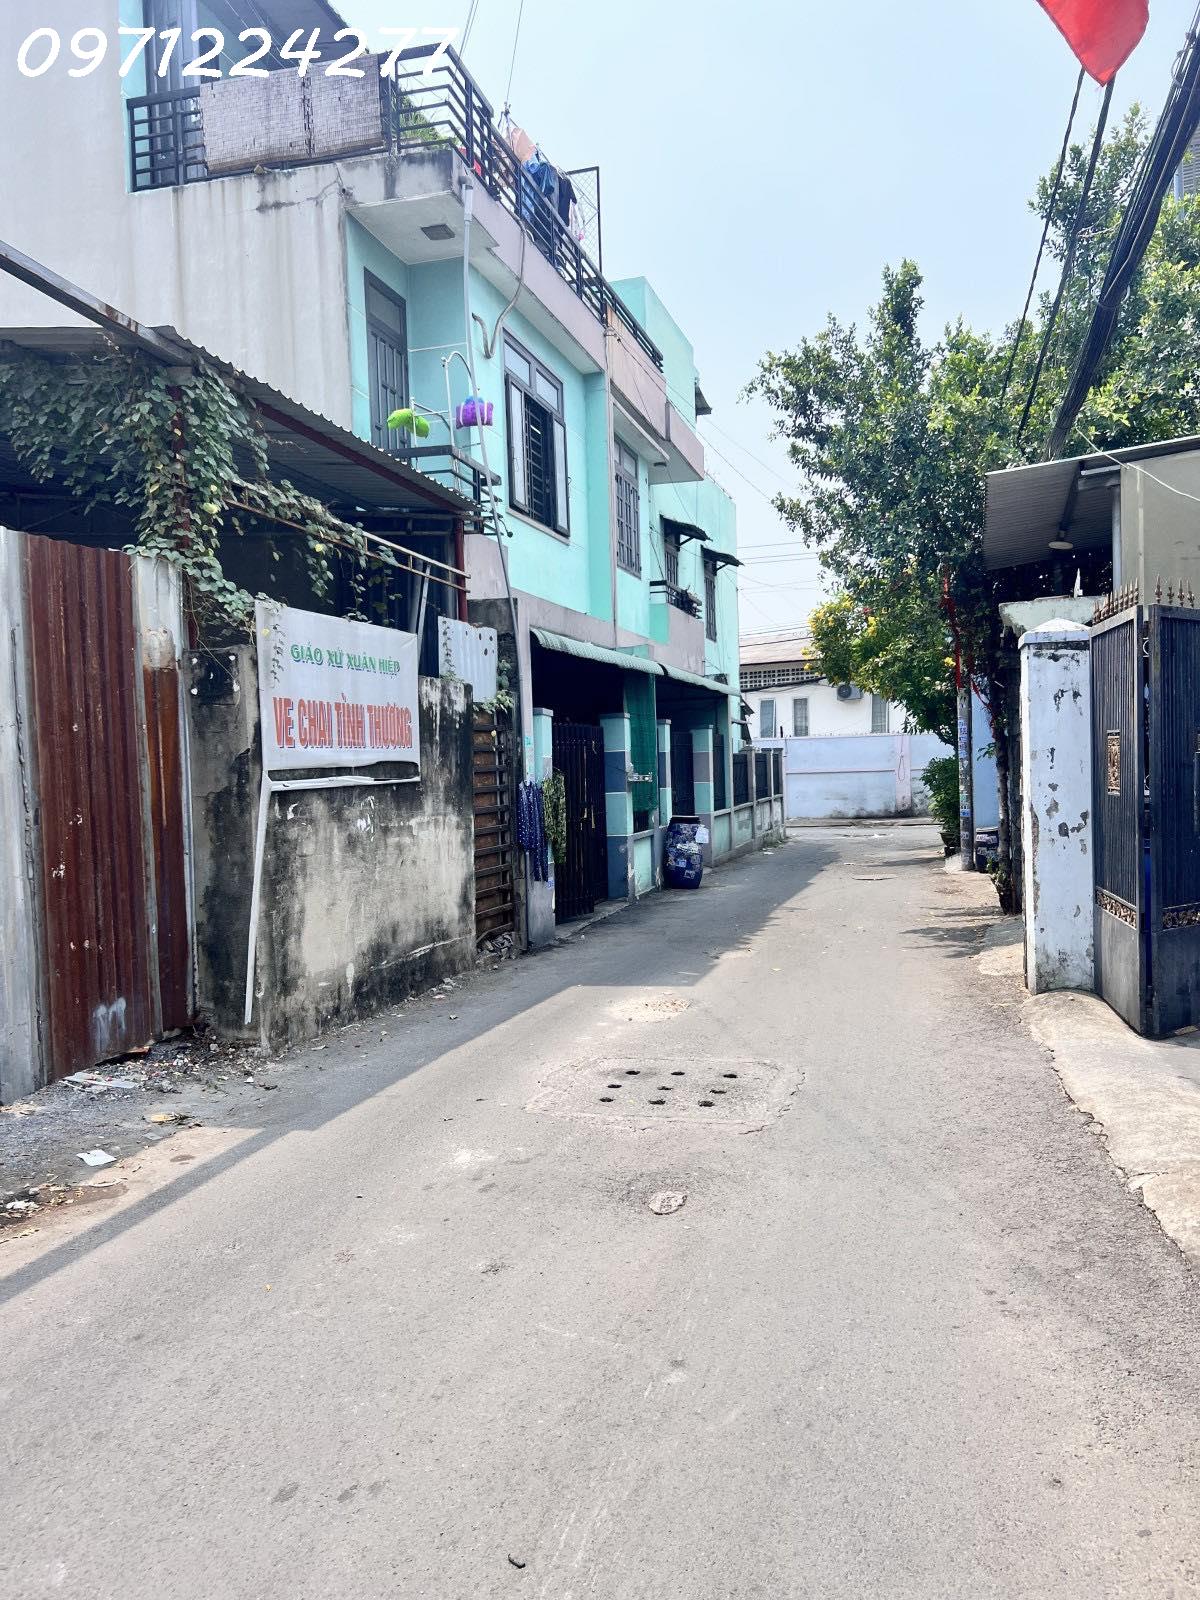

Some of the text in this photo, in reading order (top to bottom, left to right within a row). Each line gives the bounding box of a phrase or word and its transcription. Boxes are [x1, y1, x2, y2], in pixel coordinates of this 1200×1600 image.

[290, 641, 324, 666] GIÁO
[272, 696, 295, 749] VE
[297, 698, 333, 749] CHAI
[334, 692, 366, 749] TÌNH
